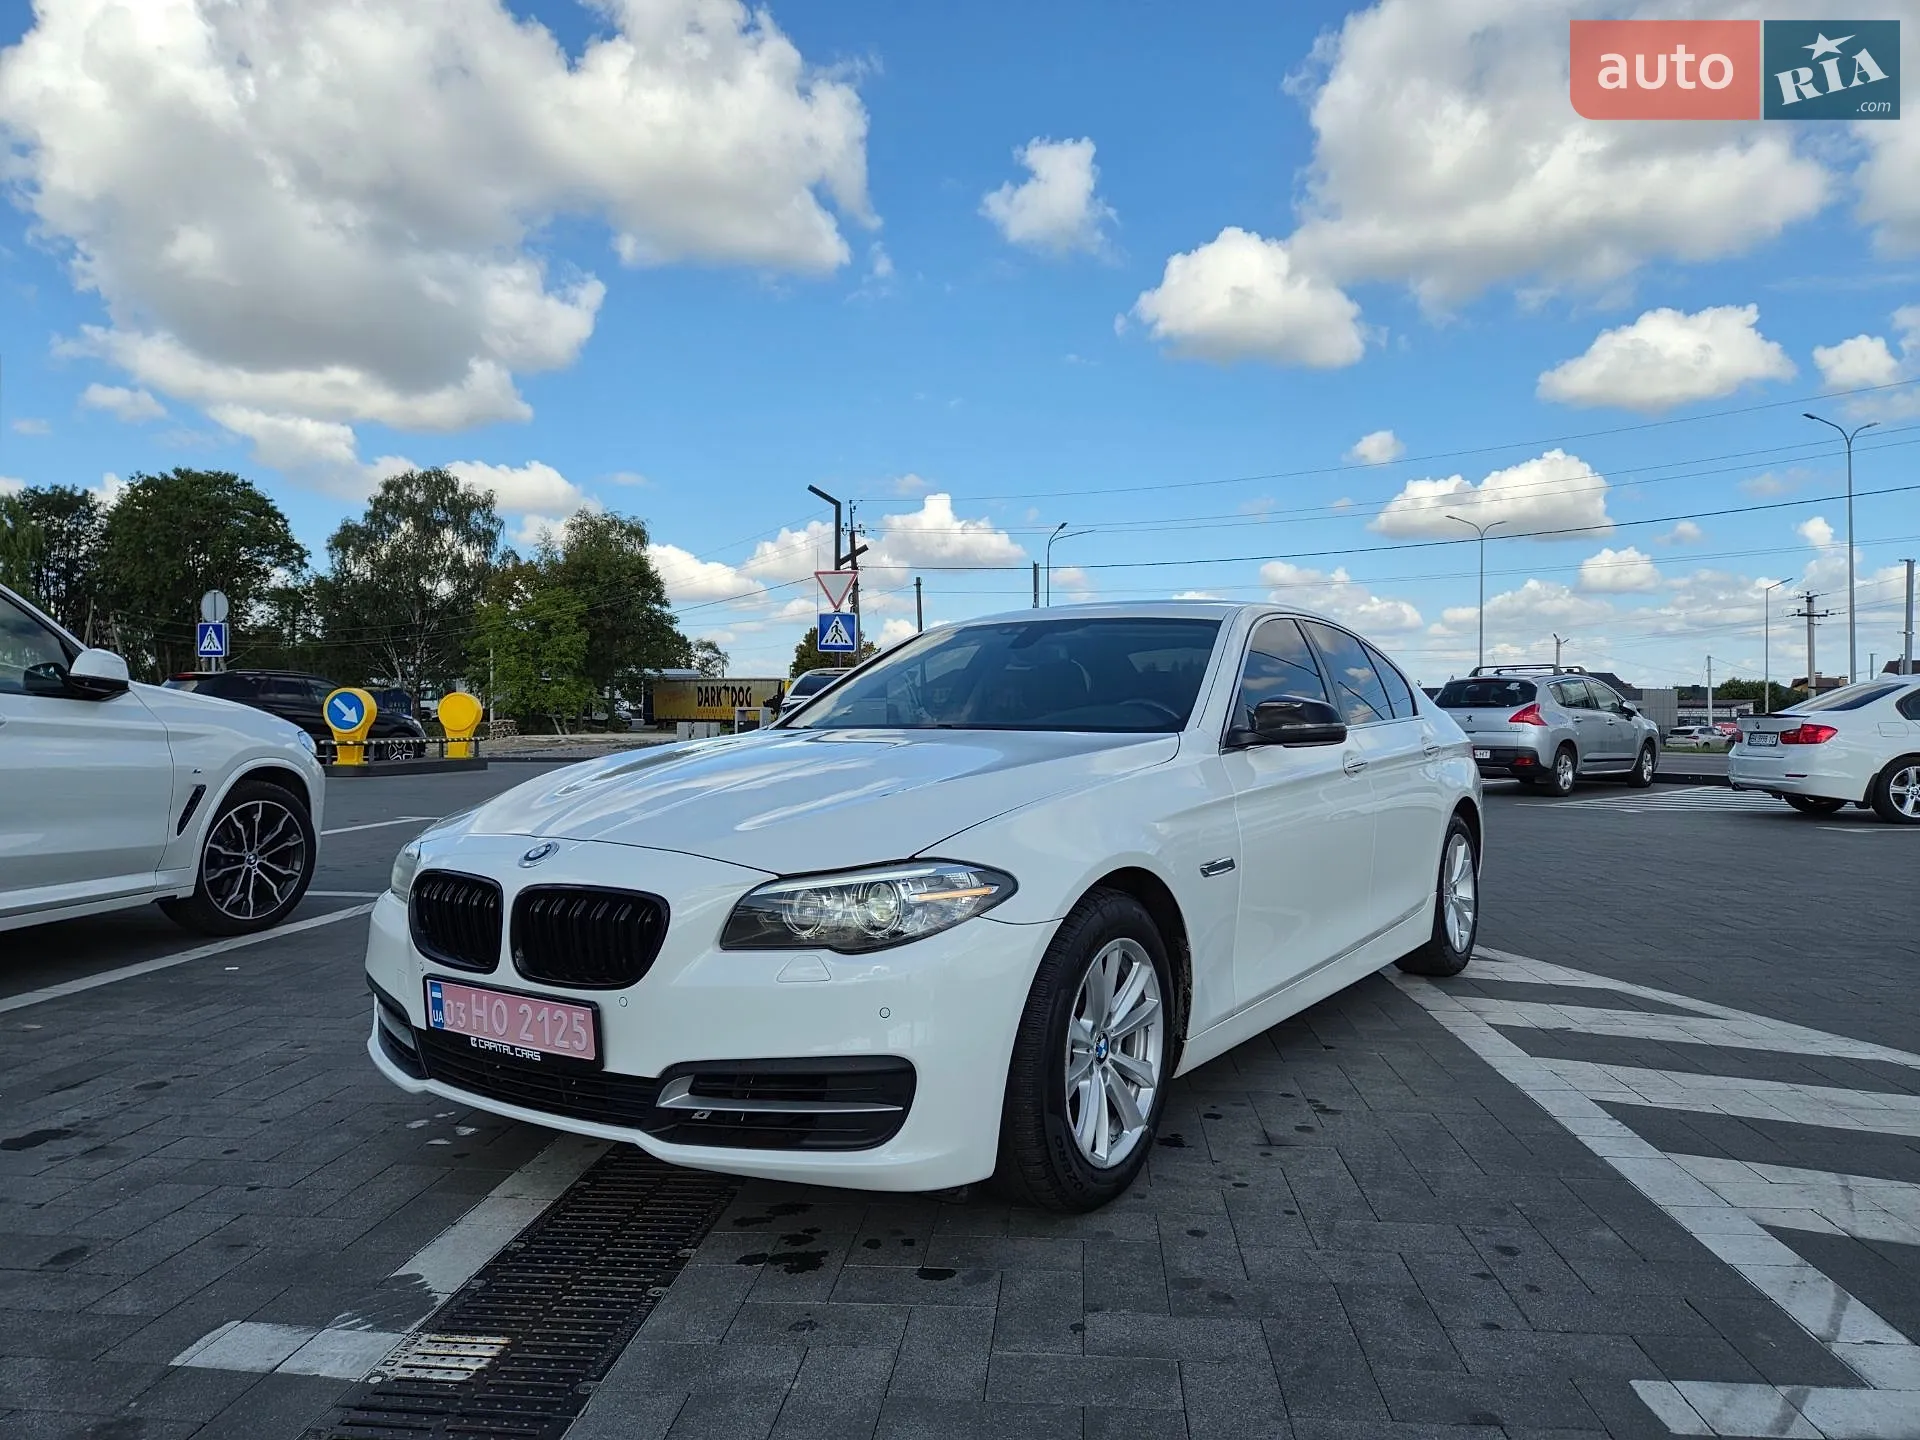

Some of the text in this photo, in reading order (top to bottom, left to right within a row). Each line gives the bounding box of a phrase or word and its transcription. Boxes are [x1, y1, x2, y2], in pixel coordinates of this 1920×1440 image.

[697, 686, 752, 707] DARK DOG
[432, 1009, 444, 1024] UA
[518, 1003, 588, 1051] 2125
[478, 1039, 541, 1061] CAPITAL CARS
